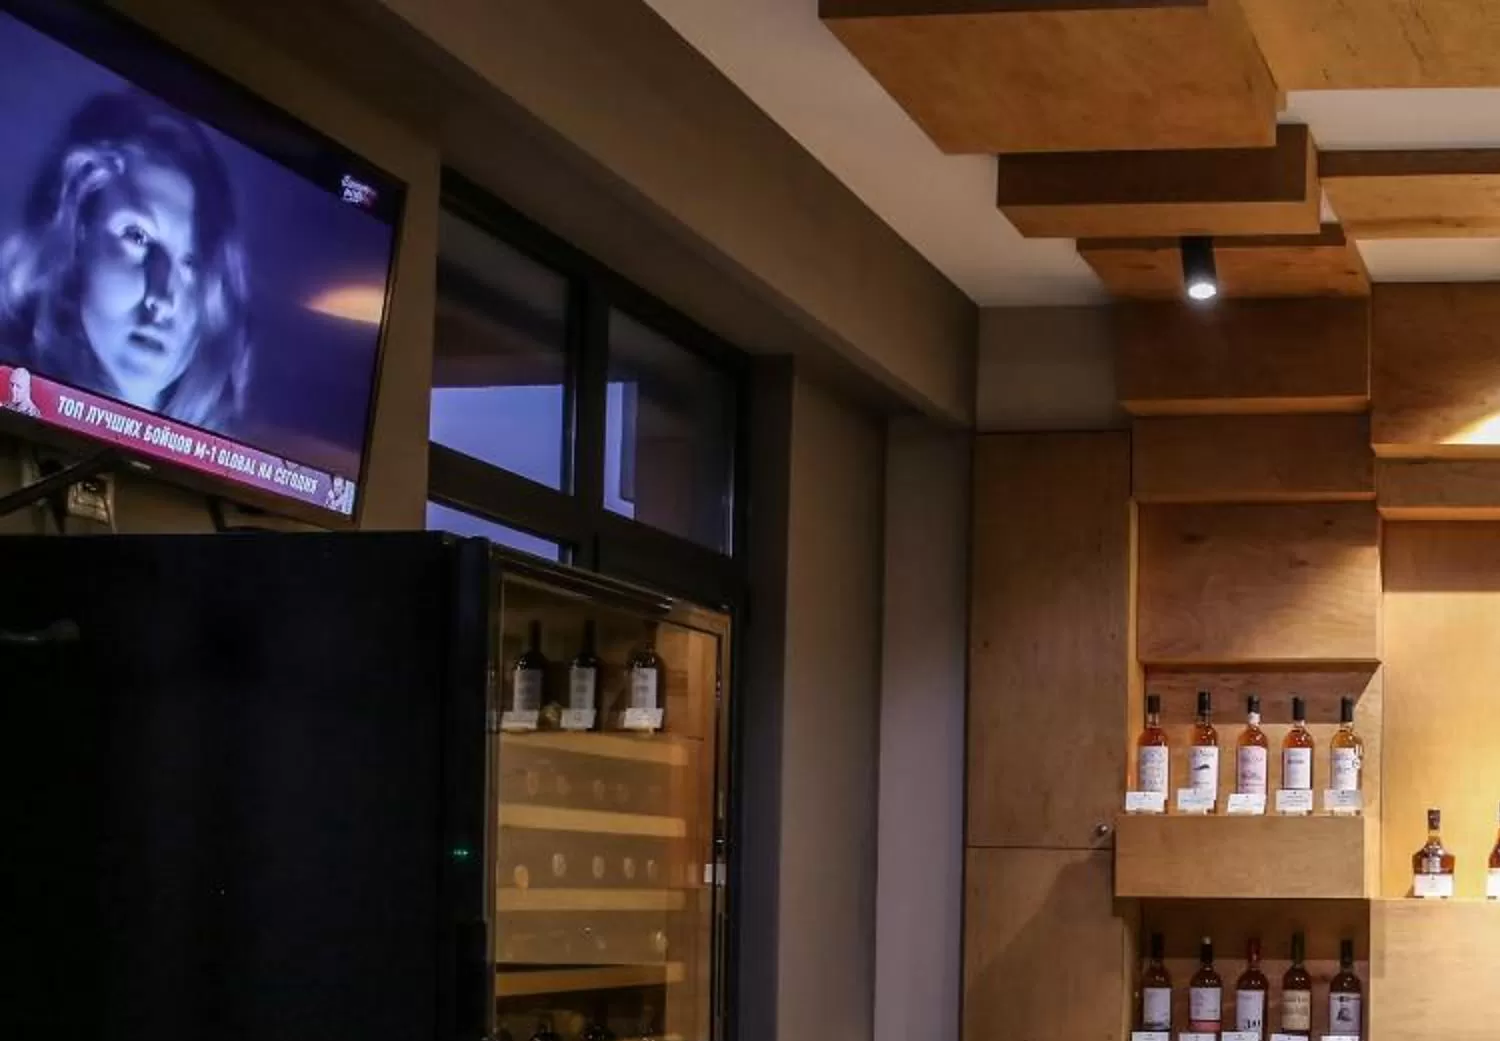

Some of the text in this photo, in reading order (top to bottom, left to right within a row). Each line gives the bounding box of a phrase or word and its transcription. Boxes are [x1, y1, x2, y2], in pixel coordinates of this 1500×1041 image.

[58, 395, 85, 420] ТОП
[86, 405, 143, 438] ЛУЧШИХ
[143, 424, 193, 454] БОЙЦОВ
[217, 449, 257, 475] GLOBAL
[258, 462, 273, 480] НА
